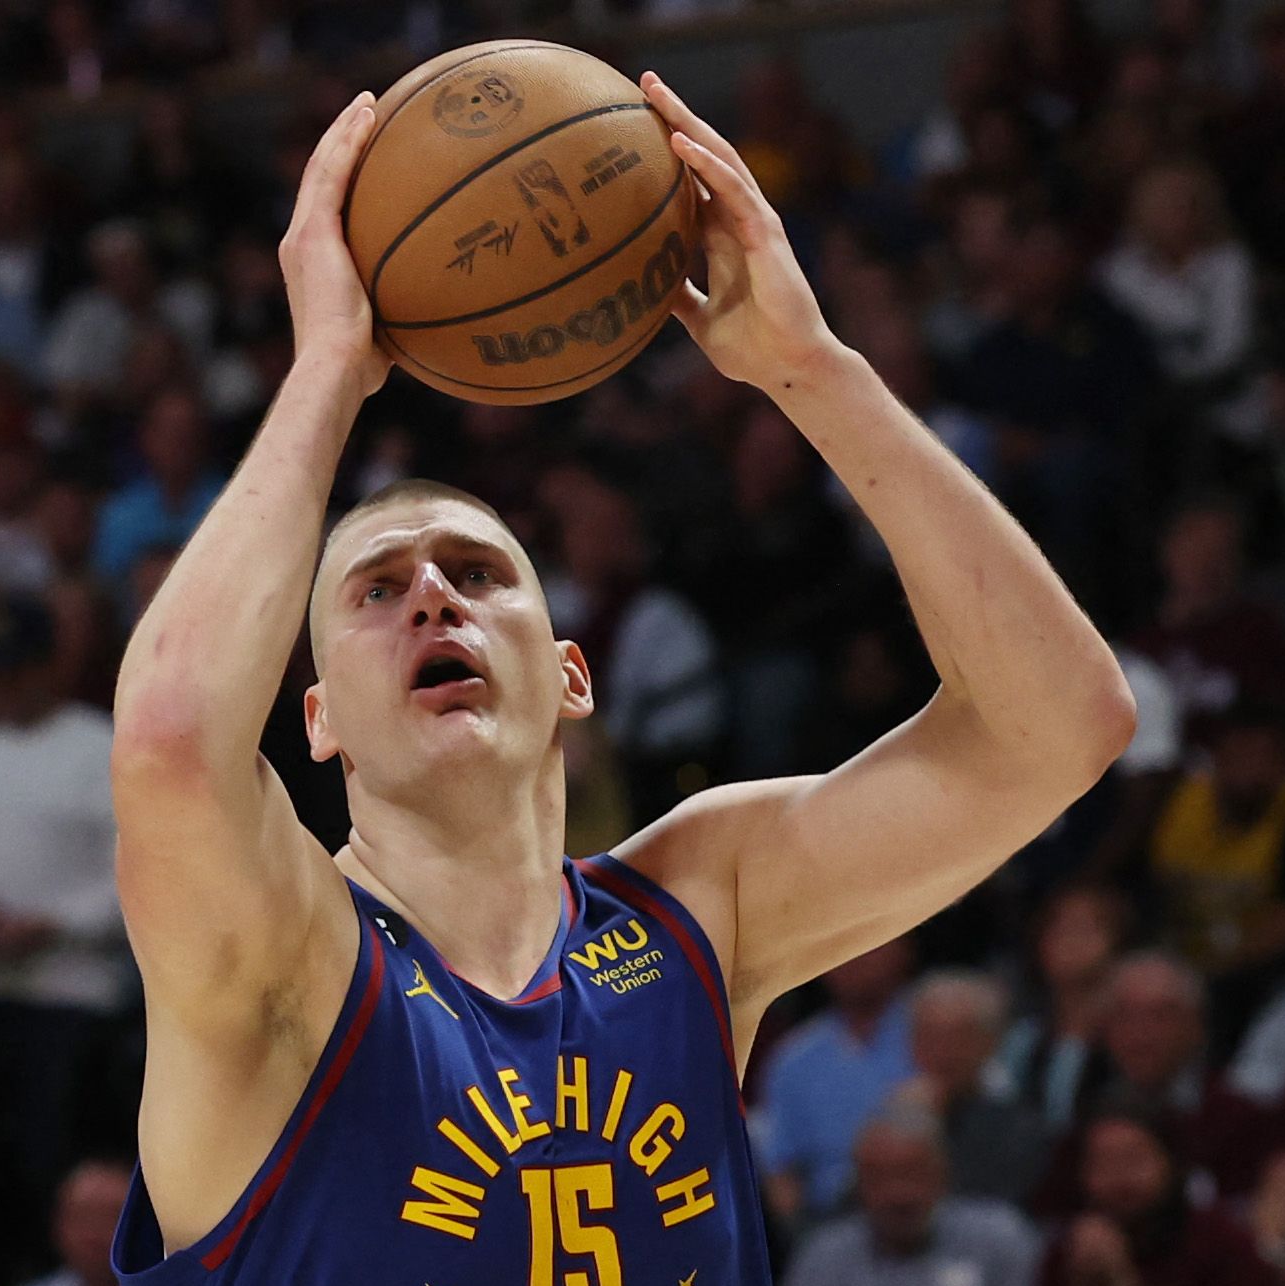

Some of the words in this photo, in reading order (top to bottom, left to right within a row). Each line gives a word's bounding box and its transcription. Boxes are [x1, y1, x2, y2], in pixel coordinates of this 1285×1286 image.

[568, 919, 648, 970] WU
[589, 949, 663, 987] Western
[610, 968, 662, 995] Union
[554, 1054, 715, 1229] HIGH
